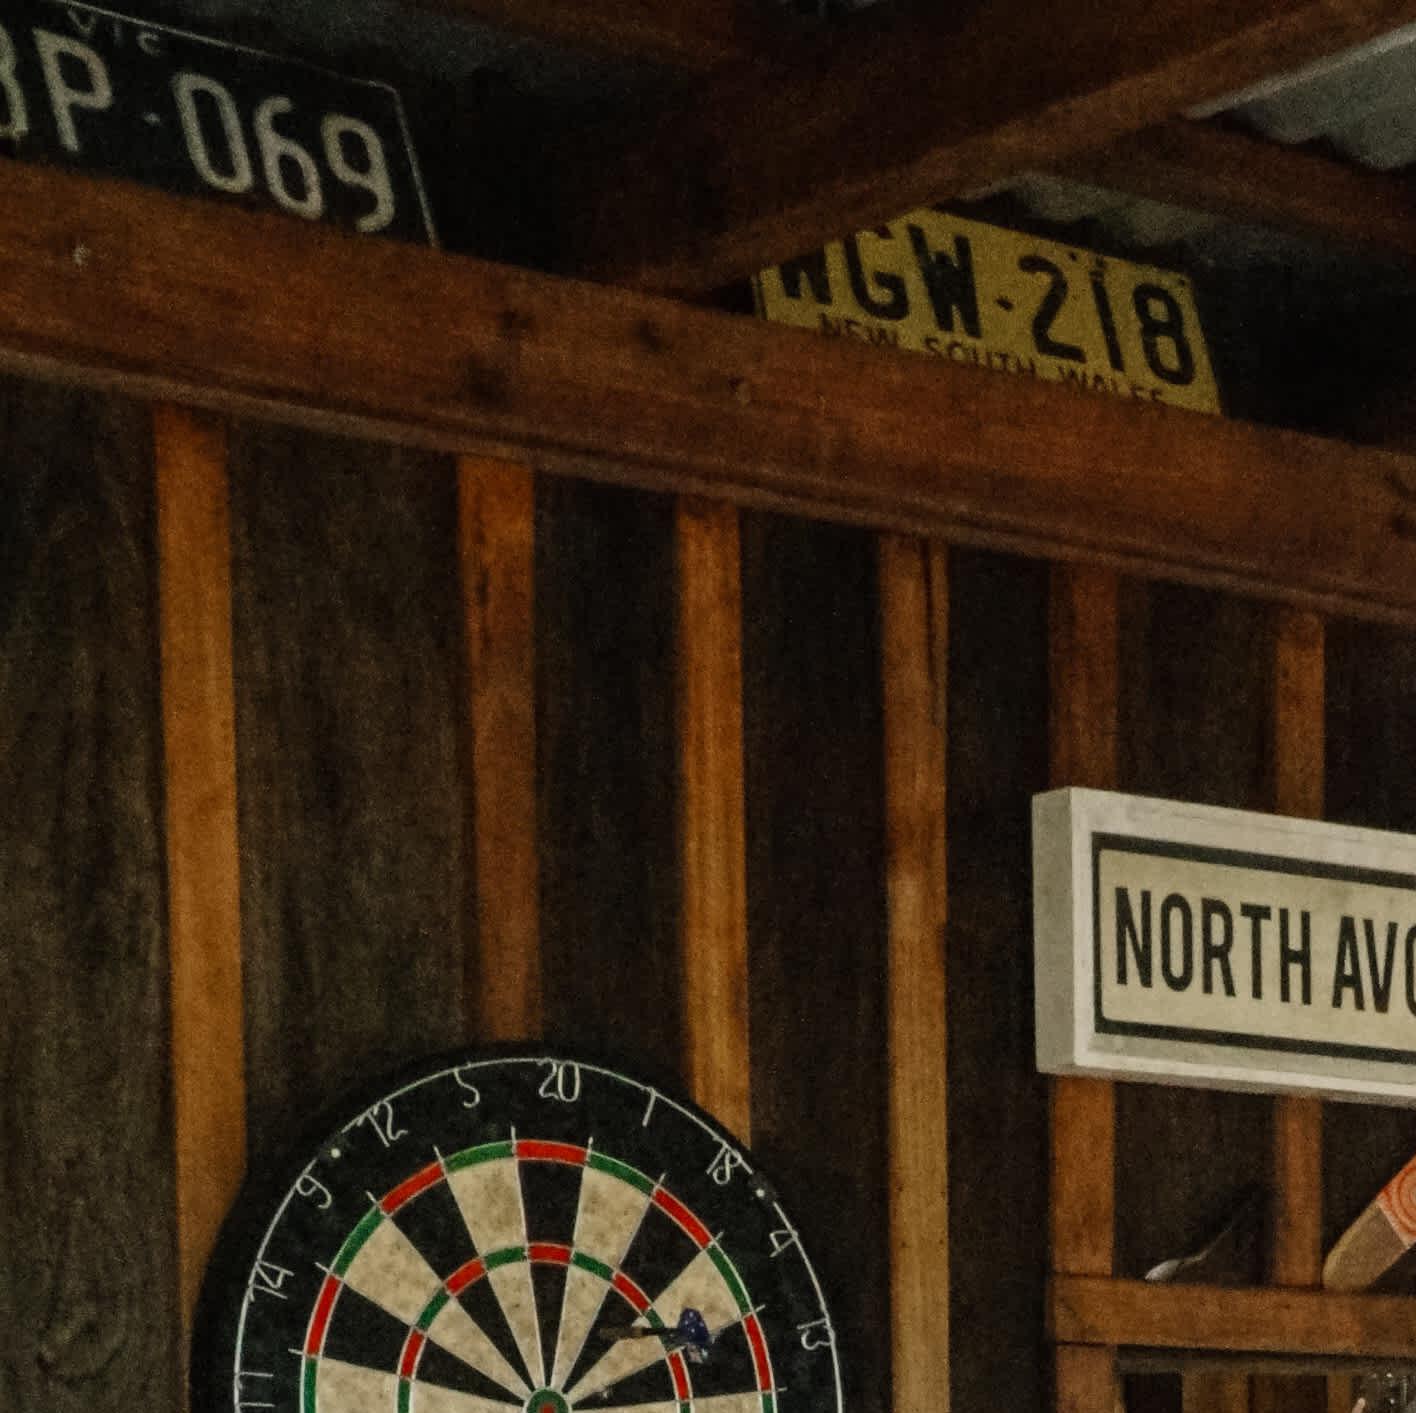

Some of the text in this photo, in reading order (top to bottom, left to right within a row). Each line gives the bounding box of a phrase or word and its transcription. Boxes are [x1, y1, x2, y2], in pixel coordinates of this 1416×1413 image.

[1115, 887, 1312, 1005] NORTH
[453, 1062, 481, 1108] 5
[537, 1058, 580, 1102] 20
[356, 1099, 408, 1147] 12
[706, 1134, 743, 1185] 18
[296, 1173, 332, 1209] 9
[769, 1229, 798, 1257] 4
[248, 1260, 294, 1302] 14
[797, 1317, 836, 1350] 13
